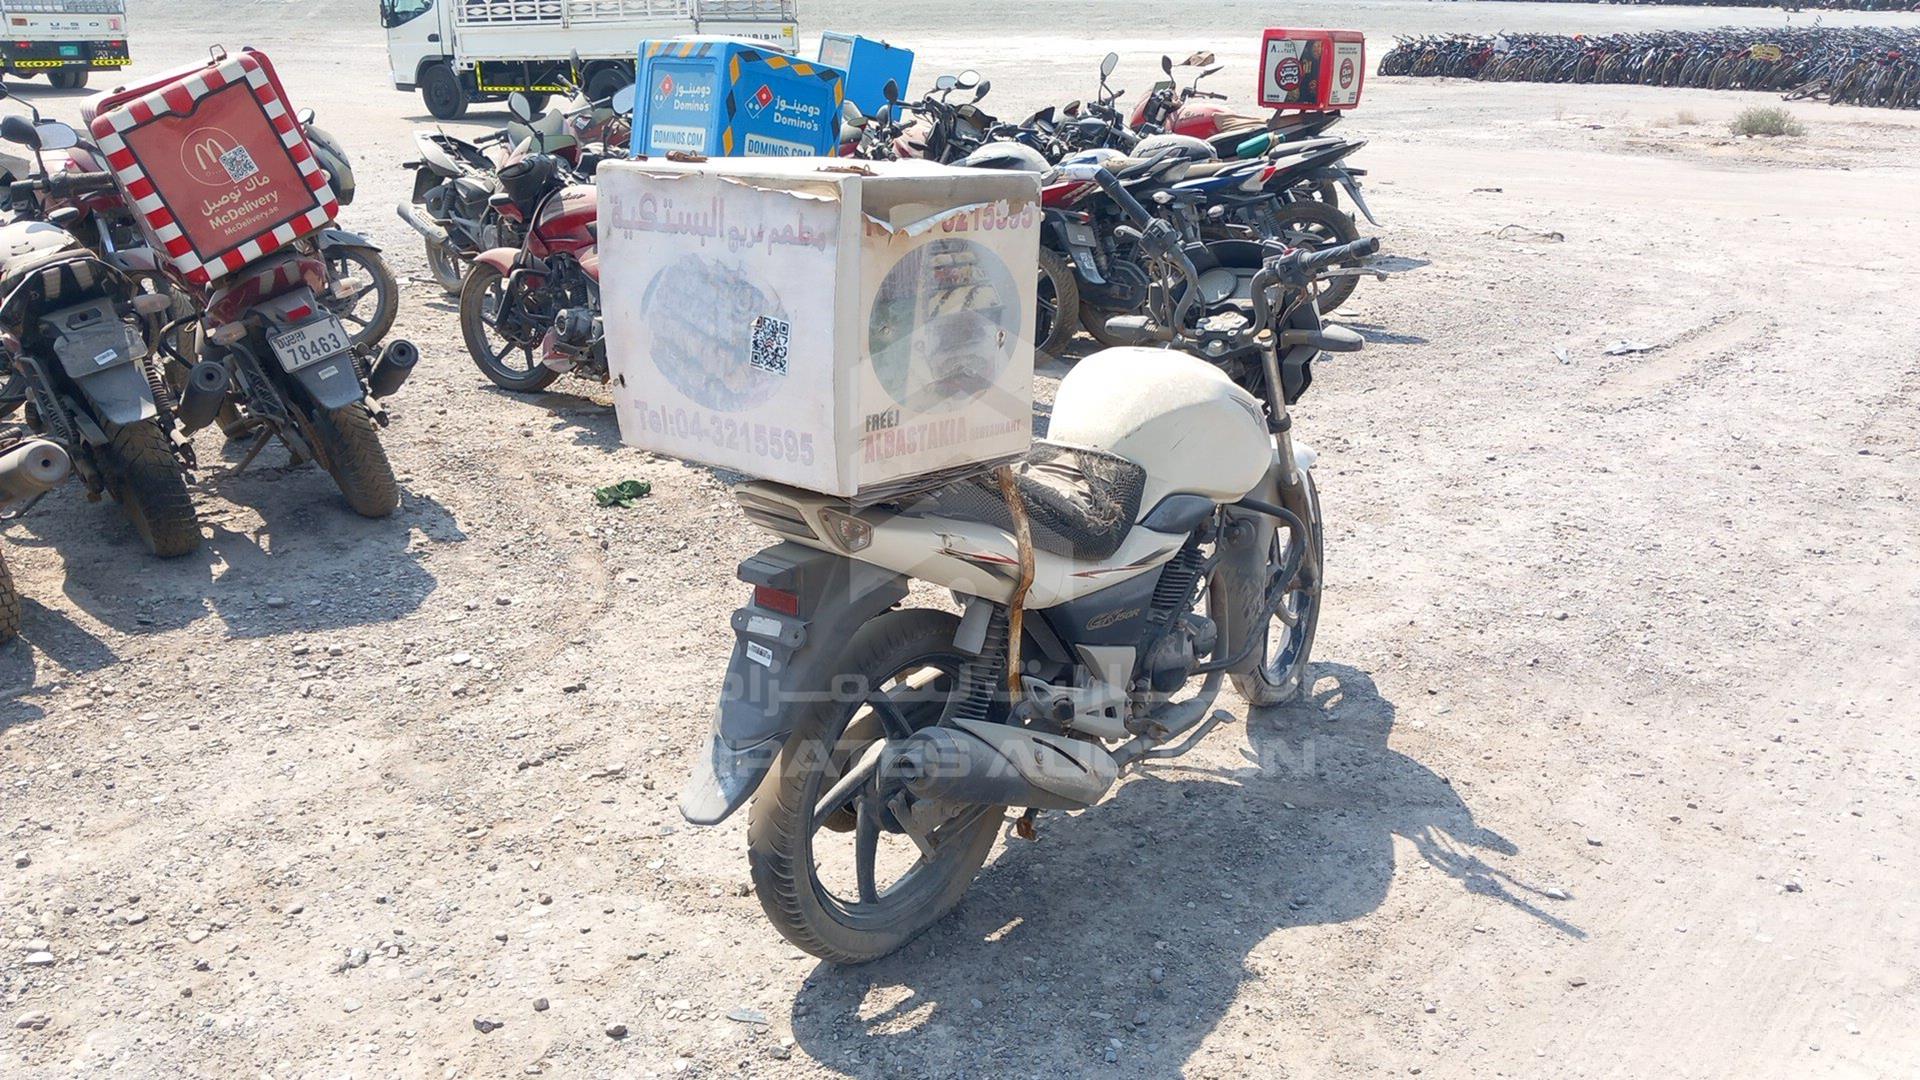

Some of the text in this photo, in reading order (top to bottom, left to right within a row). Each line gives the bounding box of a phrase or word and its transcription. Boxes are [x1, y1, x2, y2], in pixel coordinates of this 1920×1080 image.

[673, 99, 710, 112] Domino's
[773, 111, 819, 132] Domino's
[653, 129, 703, 146] DOMINOS.COM
[209, 190, 278, 230] McDelivery
[287, 333, 341, 365] 78463
